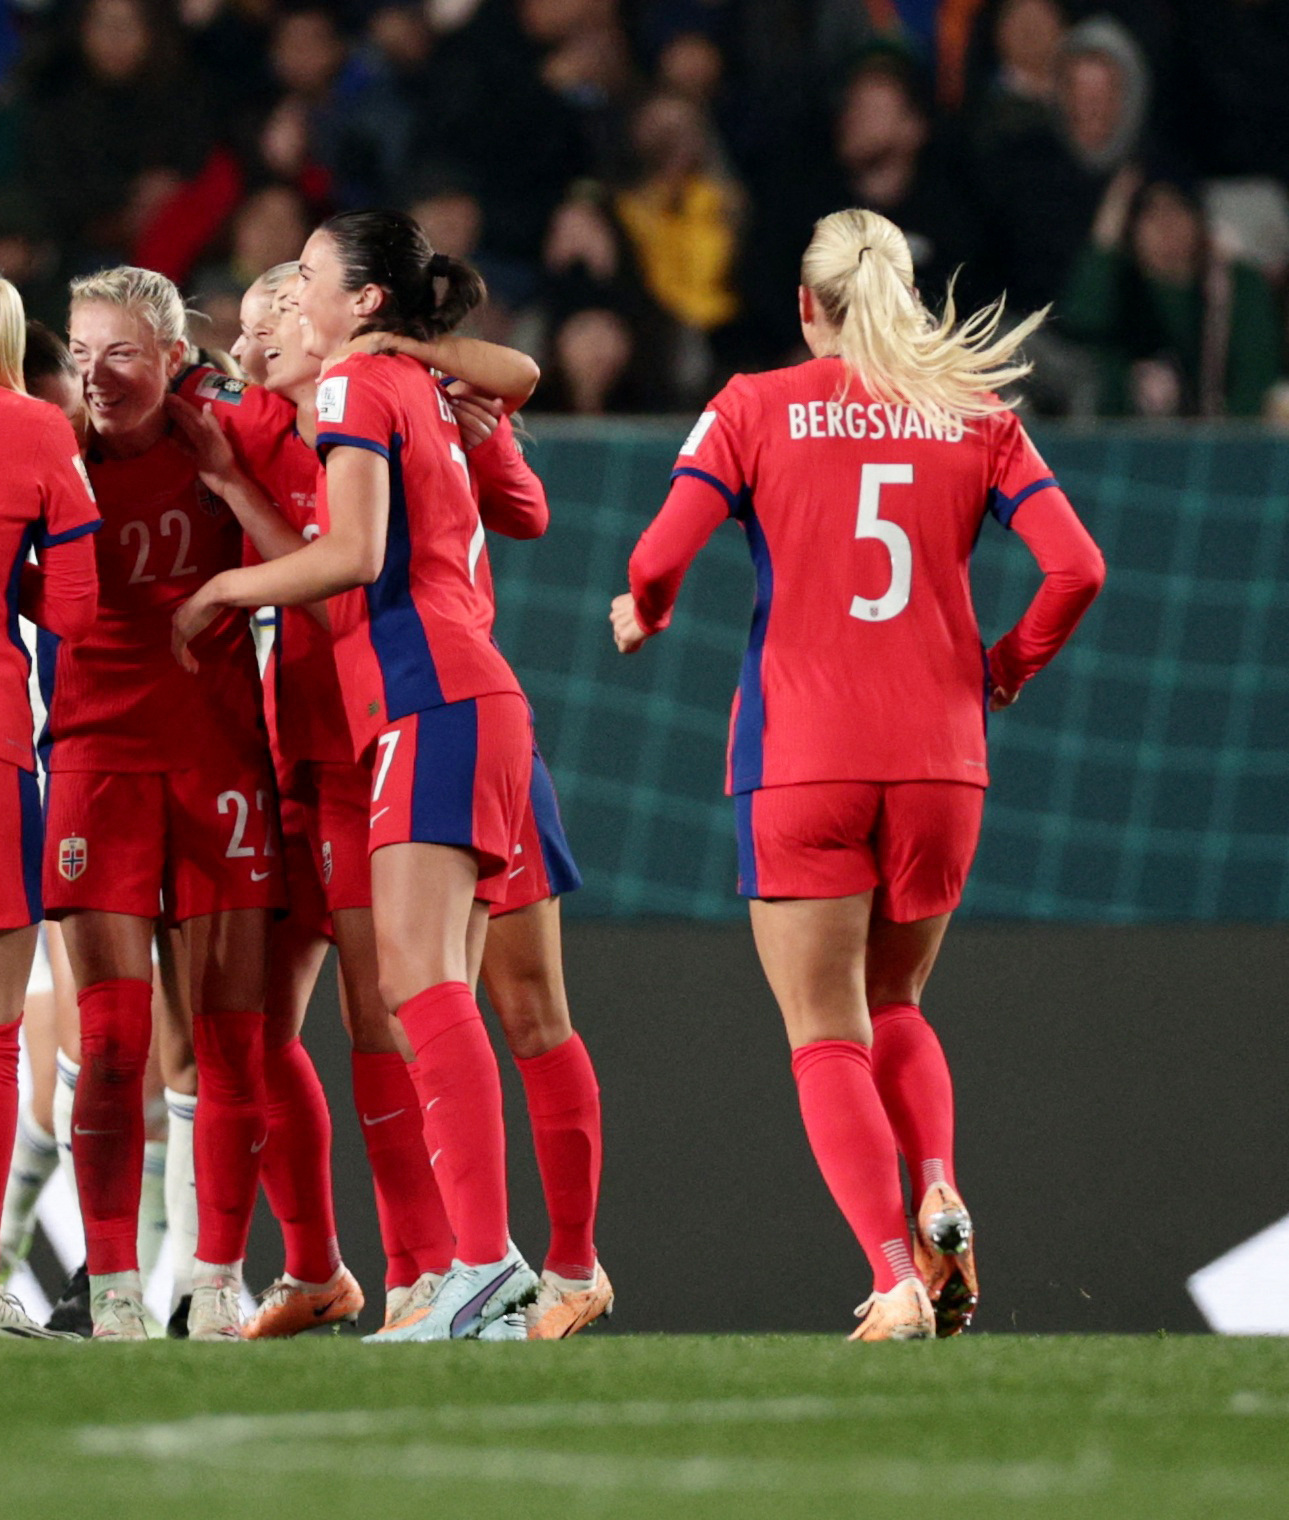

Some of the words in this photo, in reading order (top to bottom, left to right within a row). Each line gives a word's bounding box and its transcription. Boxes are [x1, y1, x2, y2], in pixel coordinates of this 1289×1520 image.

[120, 509, 198, 585] 22
[849, 463, 914, 622] 5
[372, 729, 401, 802] 7
